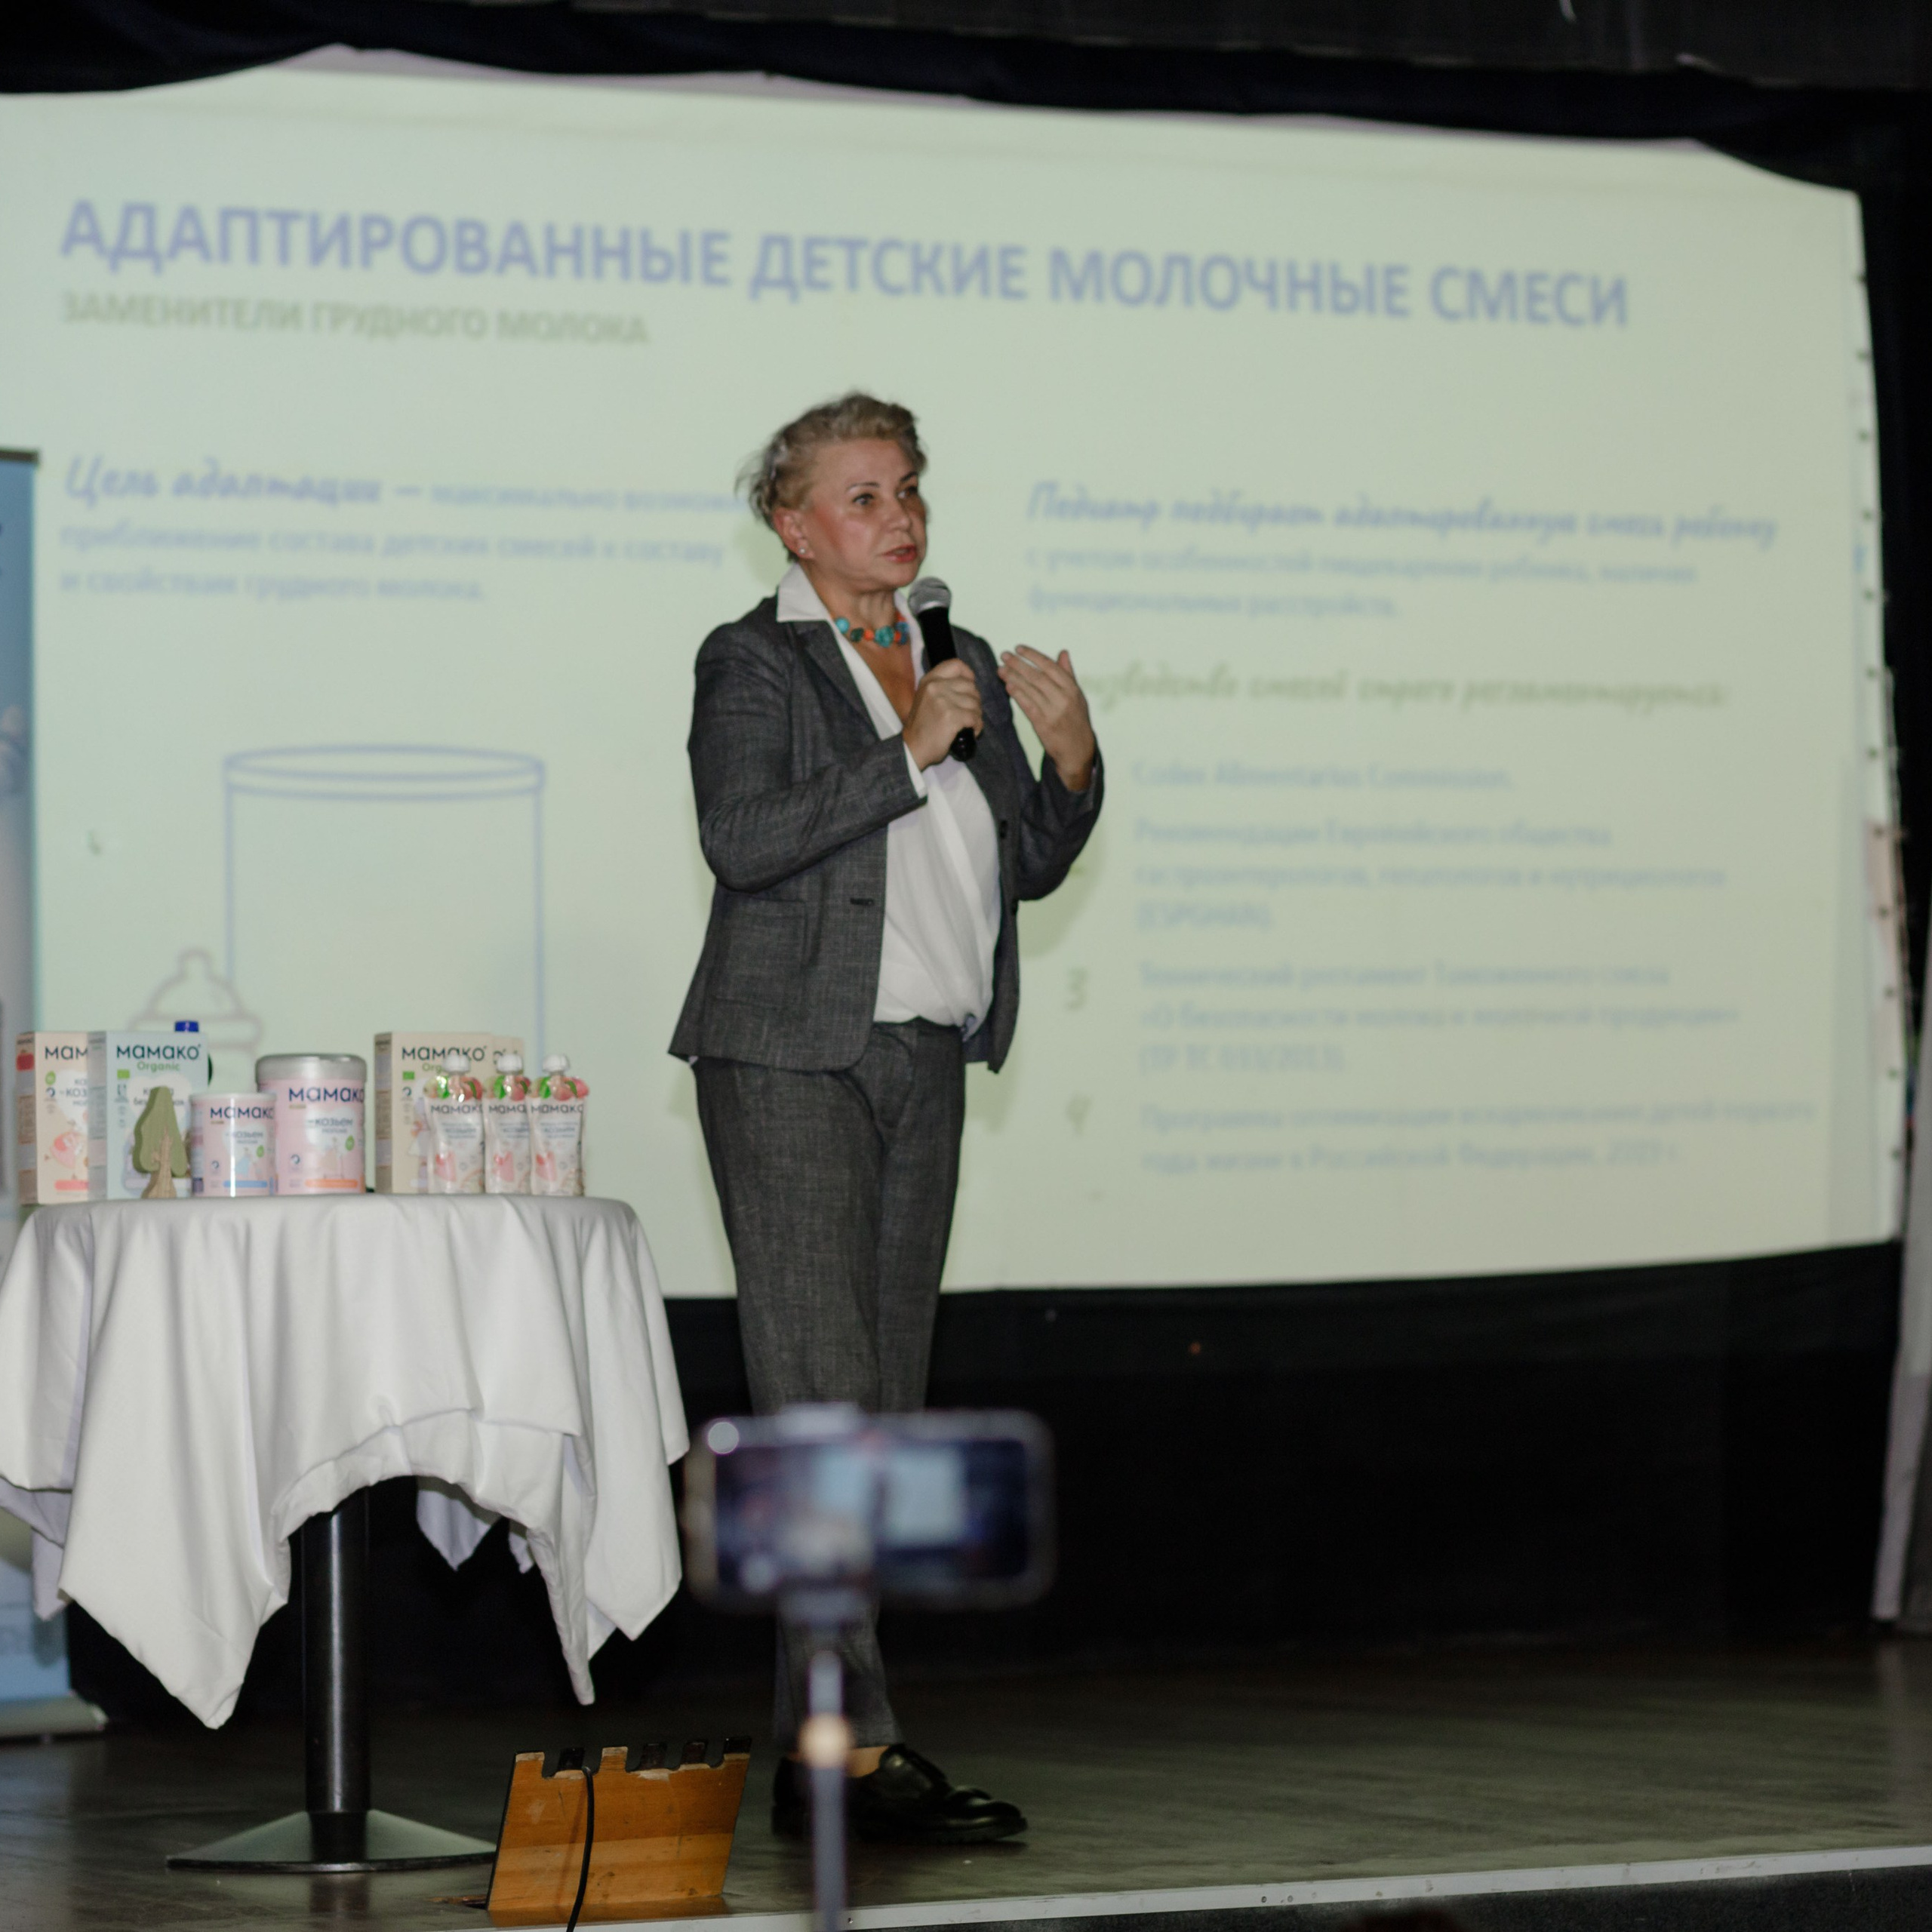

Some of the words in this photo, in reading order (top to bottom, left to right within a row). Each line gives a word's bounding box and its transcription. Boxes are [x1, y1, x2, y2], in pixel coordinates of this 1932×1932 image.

[60, 198, 731, 287] АДАПТИРОВАННЫЕ
[749, 234, 1027, 301] ДЕТСКИЕ
[1048, 248, 1411, 318] МОЛОЧНЫЕ
[1430, 266, 1628, 328] СМЕСИ
[62, 290, 301, 331] ЗАМЕНИТЕЛИ
[312, 301, 488, 342] ГРУДНОГО
[497, 309, 649, 346] МОЛОКА
[65, 454, 160, 510] Цель
[173, 455, 382, 512] адаптации
[1029, 481, 1160, 532] Педиатр
[1171, 488, 1324, 536] подбирает
[1333, 491, 1577, 546] адаптированную
[267, 531, 375, 554] состава
[382, 534, 489, 557] детских
[497, 533, 595, 559] смесей
[623, 540, 724, 569] составу
[60, 573, 80, 592] и
[245, 576, 372, 601] грудного
[1065, 966, 1089, 1012] 3
[45, 1044, 88, 1060] мам
[137, 1060, 180, 1072] Organic
[489, 1104, 528, 1114] мама
